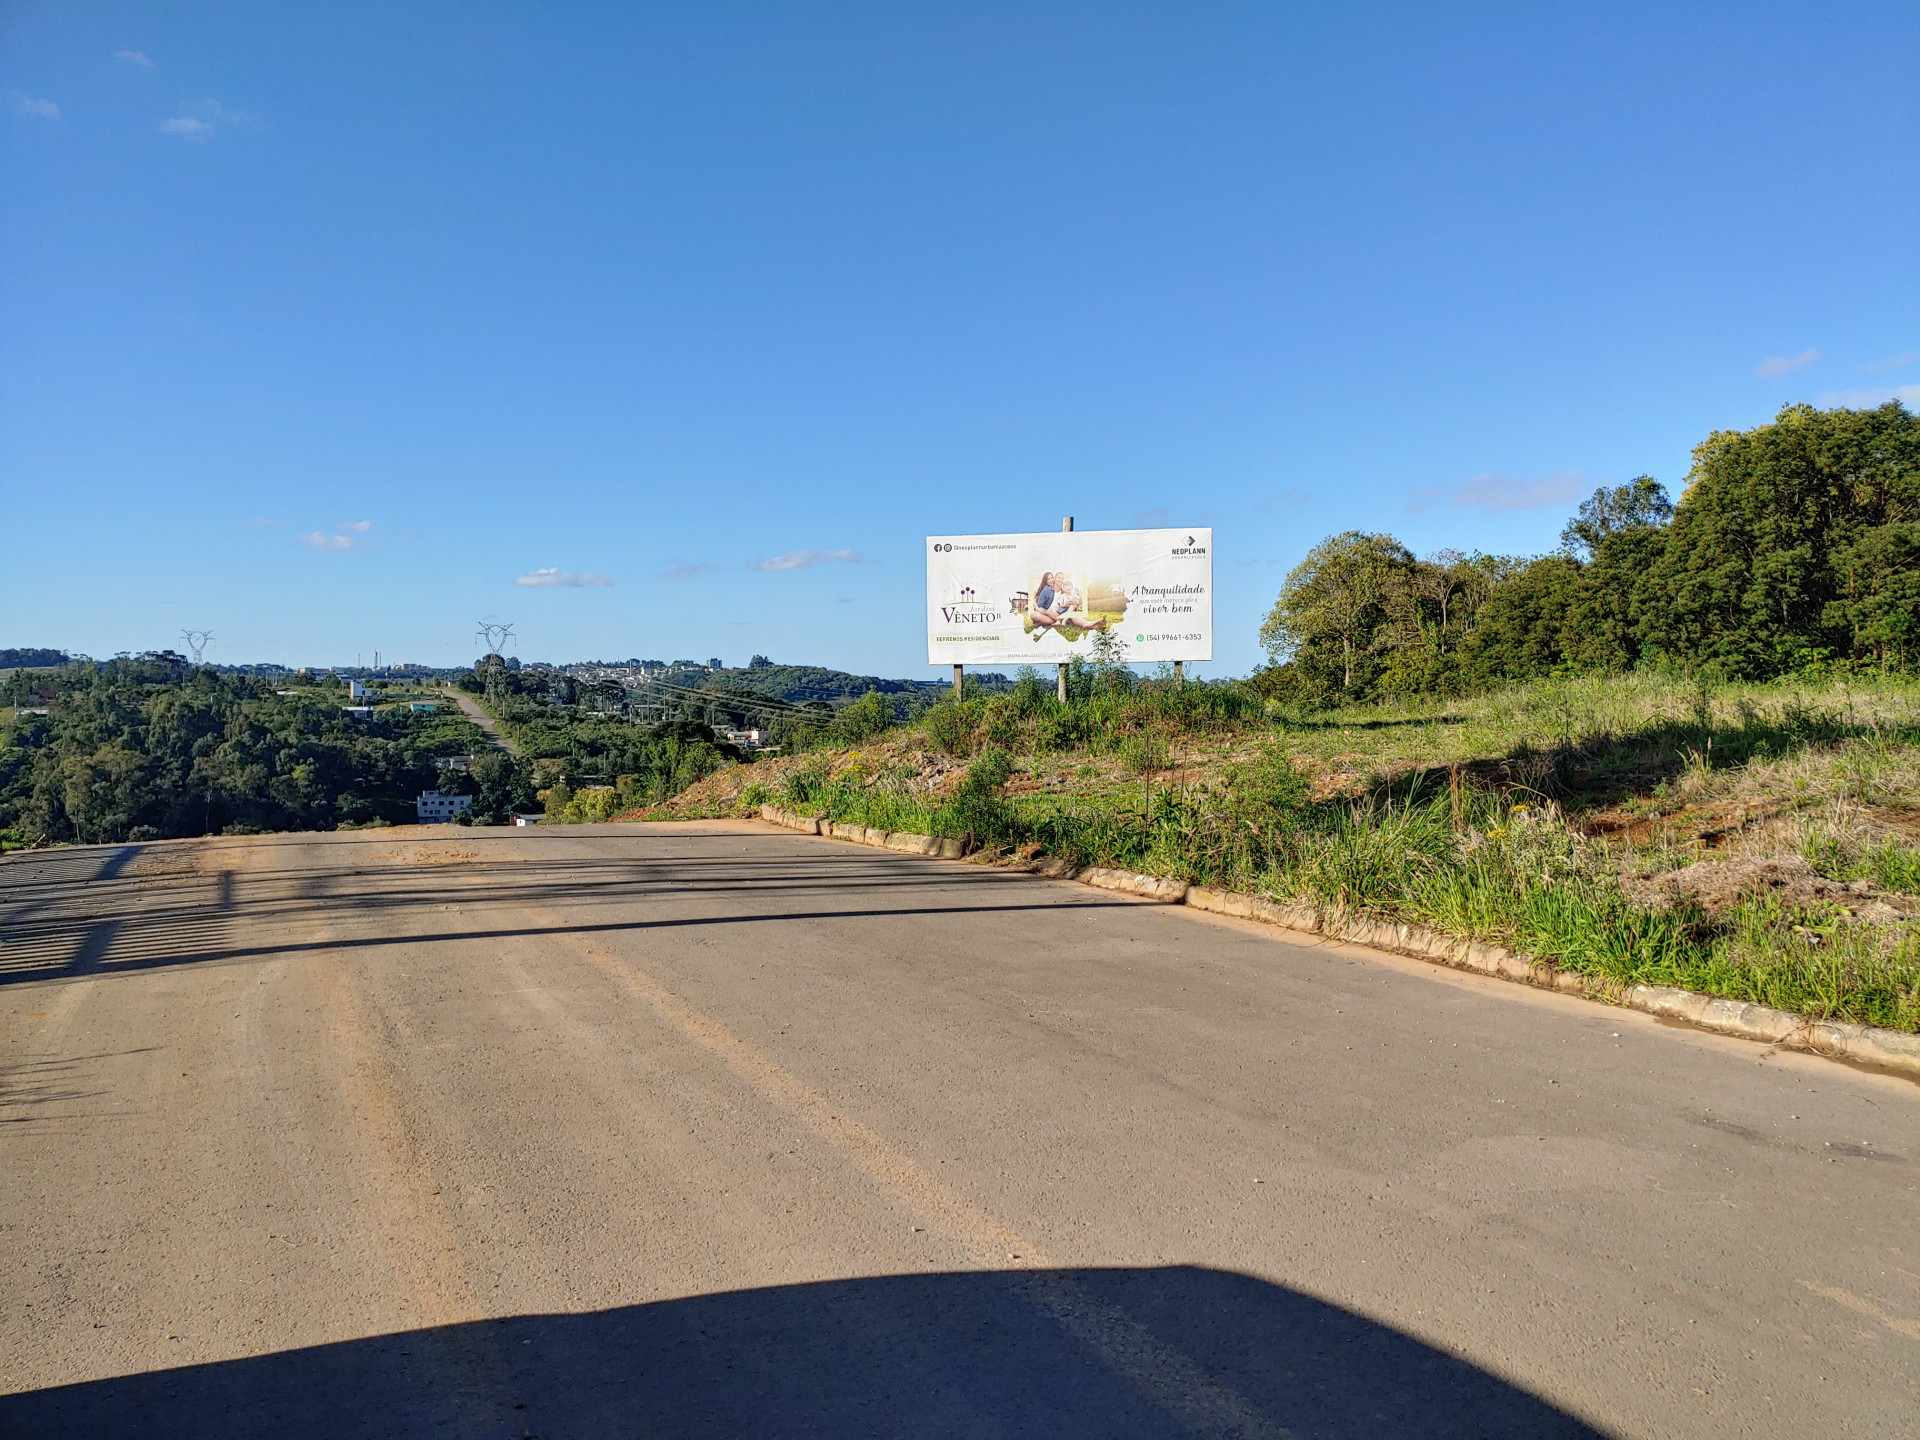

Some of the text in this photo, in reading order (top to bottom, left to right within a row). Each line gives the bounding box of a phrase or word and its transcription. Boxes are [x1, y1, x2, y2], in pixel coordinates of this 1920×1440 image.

[1132, 584, 1206, 598] A tranquilidade
[1143, 603, 1193, 613] viver bem
[941, 607, 996, 623] VÊNETO
[1146, 633, 1202, 642] (54) 99661-6353
